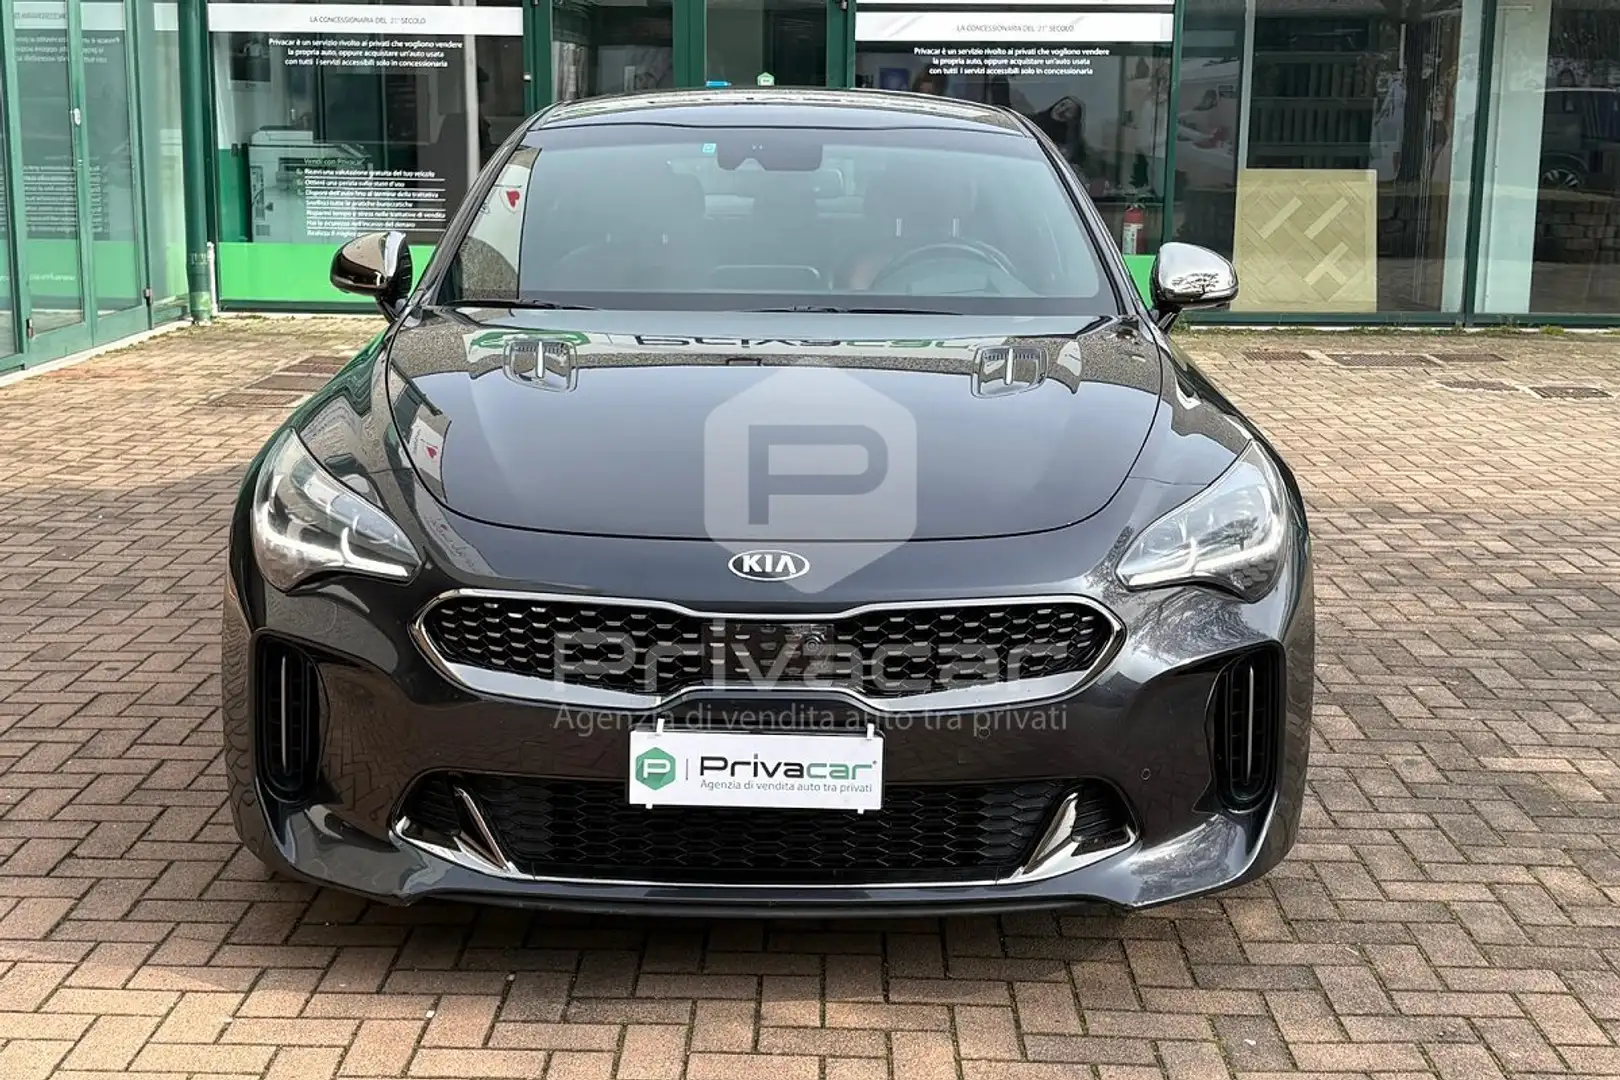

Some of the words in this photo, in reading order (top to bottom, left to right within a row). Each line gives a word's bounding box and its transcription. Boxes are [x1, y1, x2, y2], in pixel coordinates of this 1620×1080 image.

[319, 16, 374, 24] CONCESSIONARIA
[401, 16, 427, 25] SECOLO
[1049, 24, 1075, 33] SECOLO
[269, 38, 295, 46] Privacar
[369, 40, 390, 49] privati
[404, 40, 435, 49] vogliono
[295, 49, 320, 57] propria
[364, 50, 398, 58] acquistare
[913, 47, 941, 55] Privacar
[1015, 48, 1036, 57] privati
[1037, 47, 1050, 55] che
[1050, 48, 1081, 57] vogliono
[1081, 47, 1110, 56] vendere
[299, 58, 313, 66] tutti
[341, 59, 375, 67] accessibili
[398, 60, 449, 68] concessionaria
[940, 58, 965, 66] propria
[983, 59, 1009, 67] oppure
[1009, 58, 1045, 66] acquistare
[943, 67, 958, 75] tutti
[964, 67, 986, 75] servizi
[986, 67, 1020, 75] accessibili
[1021, 67, 1035, 75] solo
[1043, 67, 1094, 76] concessionaria
[743, 554, 797, 574] KIA
[700, 779, 741, 792] Agenzia
[743, 779, 754, 790] di
[756, 780, 795, 791] vendita
[797, 782, 821, 792] auto
[823, 783, 837, 793] tra
[839, 782, 872, 796] privati
